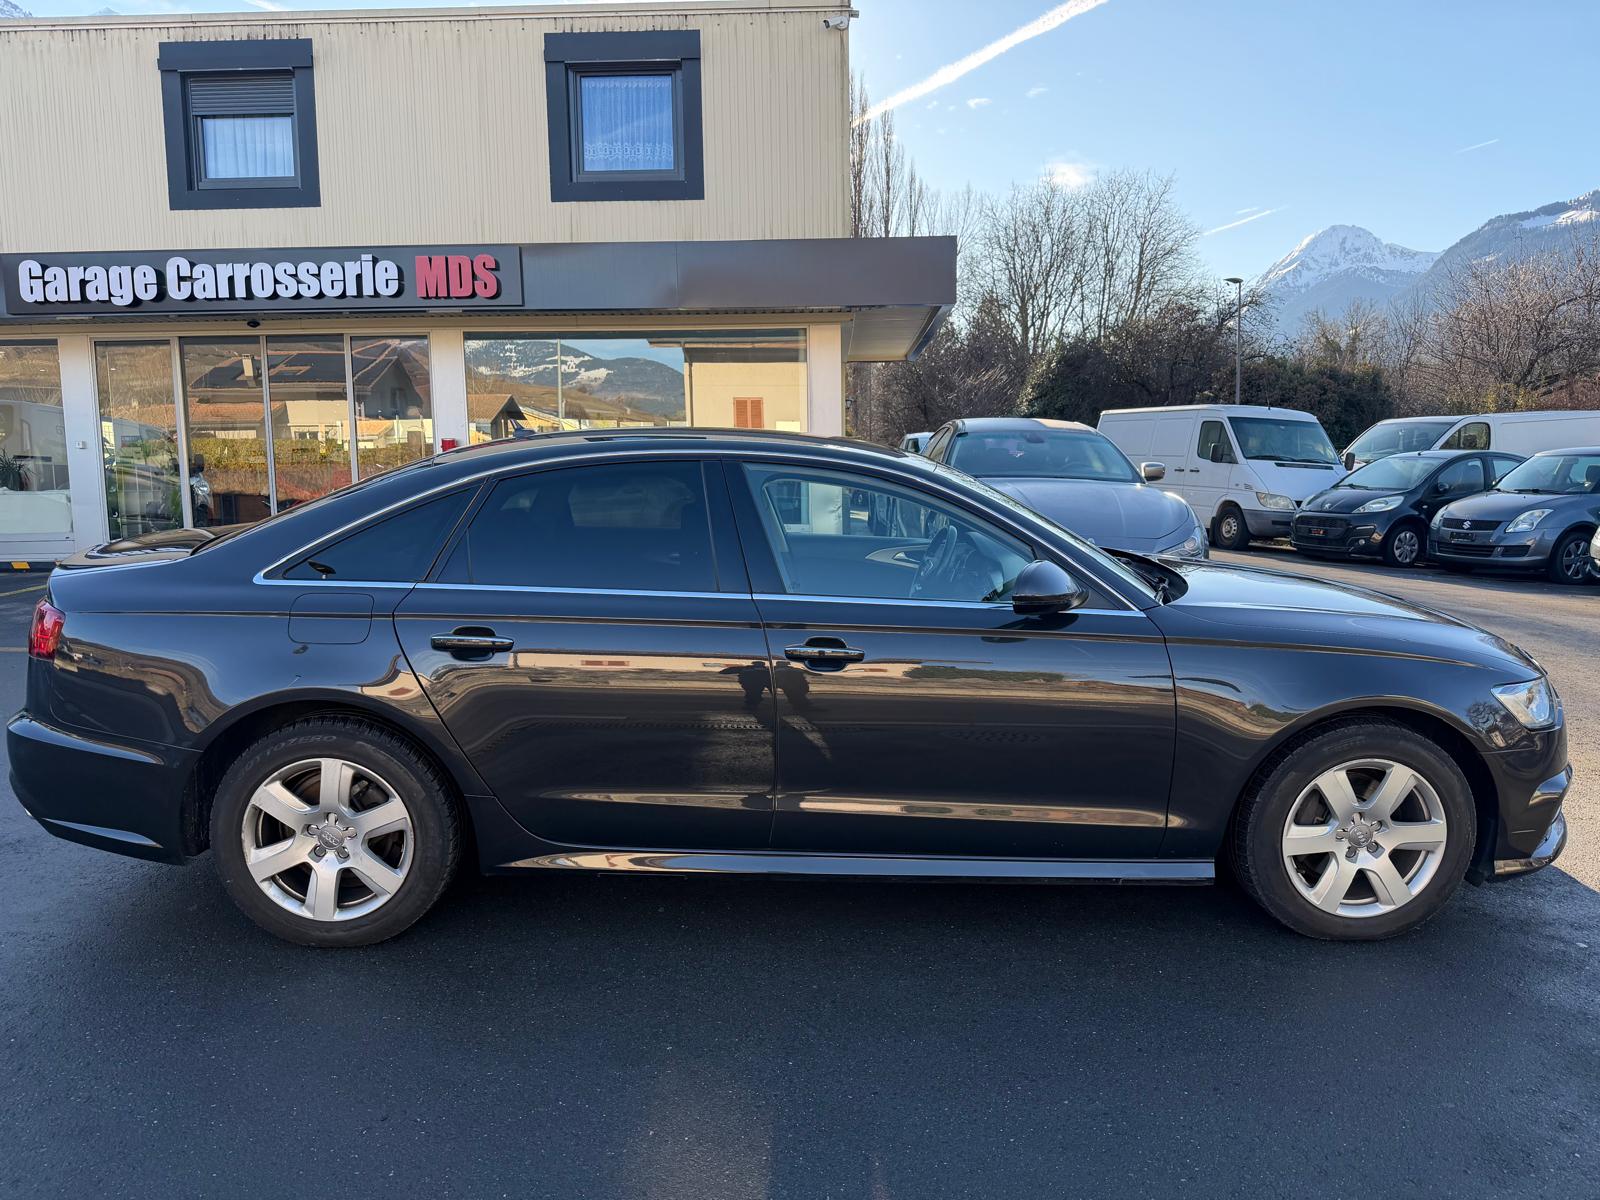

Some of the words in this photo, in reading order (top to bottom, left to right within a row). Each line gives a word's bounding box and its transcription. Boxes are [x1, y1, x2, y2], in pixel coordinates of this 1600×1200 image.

[18, 259, 158, 306] Garage
[166, 254, 399, 300] Carrosserie
[415, 254, 498, 298] MDS
